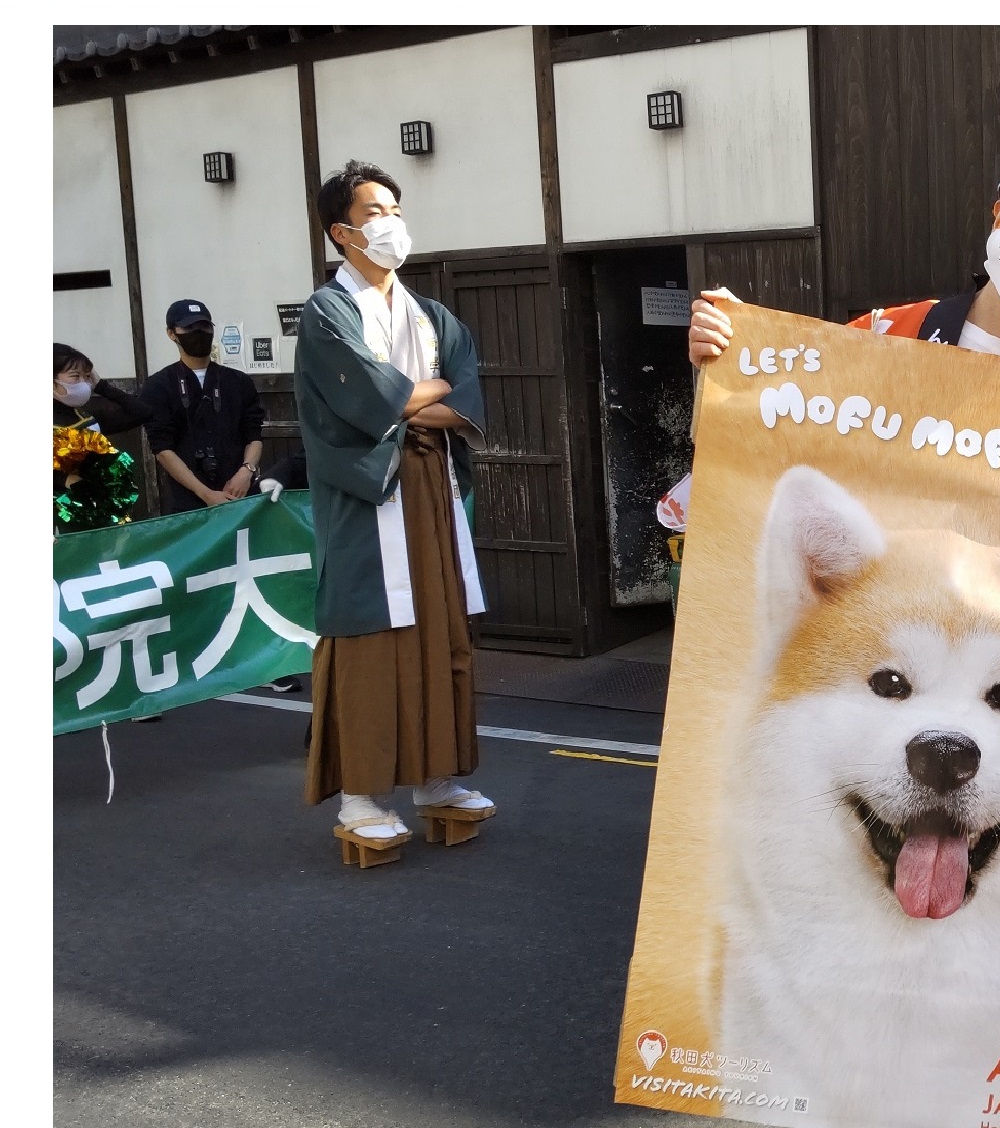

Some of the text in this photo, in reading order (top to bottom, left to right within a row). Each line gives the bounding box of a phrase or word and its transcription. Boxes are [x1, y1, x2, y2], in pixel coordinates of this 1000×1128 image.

[255, 341, 268, 349] Uber
[739, 343, 821, 376] LET'S
[631, 1074, 790, 1110] VISITAKITA.COM
